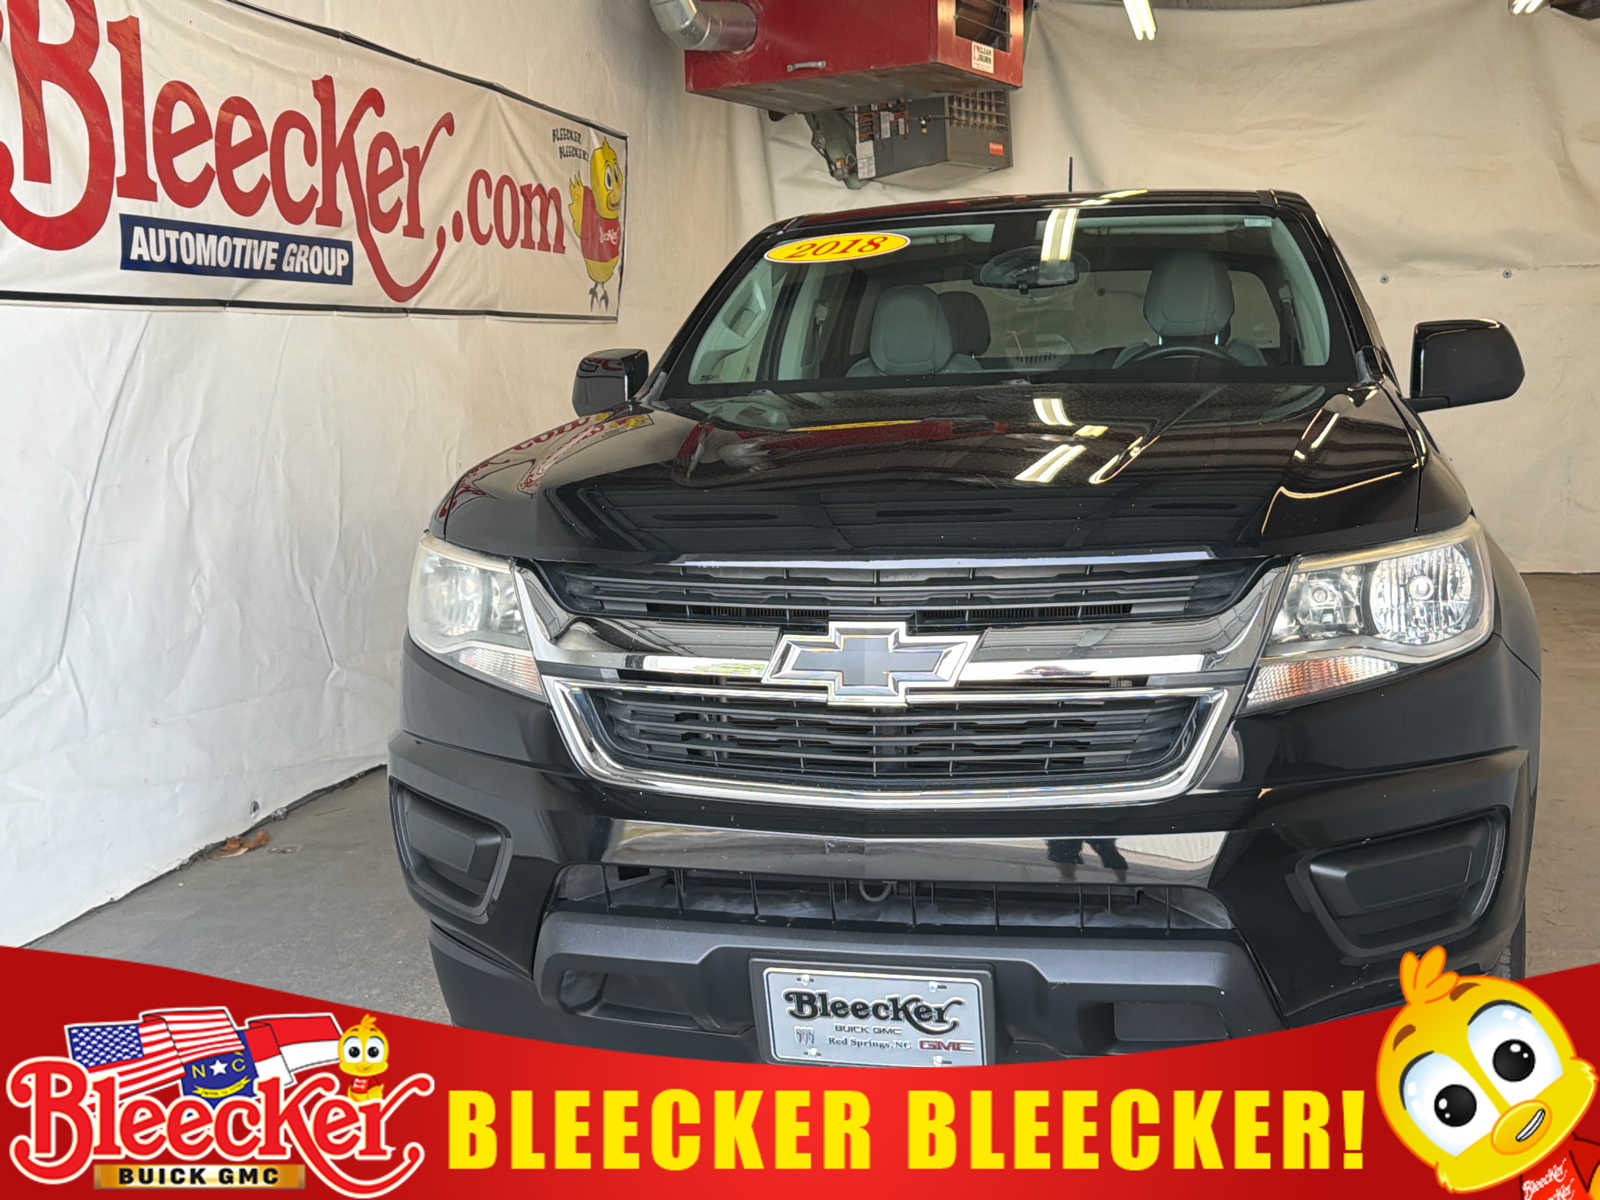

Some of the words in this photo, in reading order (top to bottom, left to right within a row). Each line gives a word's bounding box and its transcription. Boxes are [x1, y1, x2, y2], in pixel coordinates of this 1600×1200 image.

[130, 226, 279, 273] AUTOMOTIVE
[281, 241, 350, 277] GROUP
[788, 236, 889, 259] 2018
[784, 989, 964, 1035] Bleecker
[835, 1025, 869, 1033] BUICK
[873, 1027, 903, 1035] GMC
[919, 1040, 975, 1052] GMC
